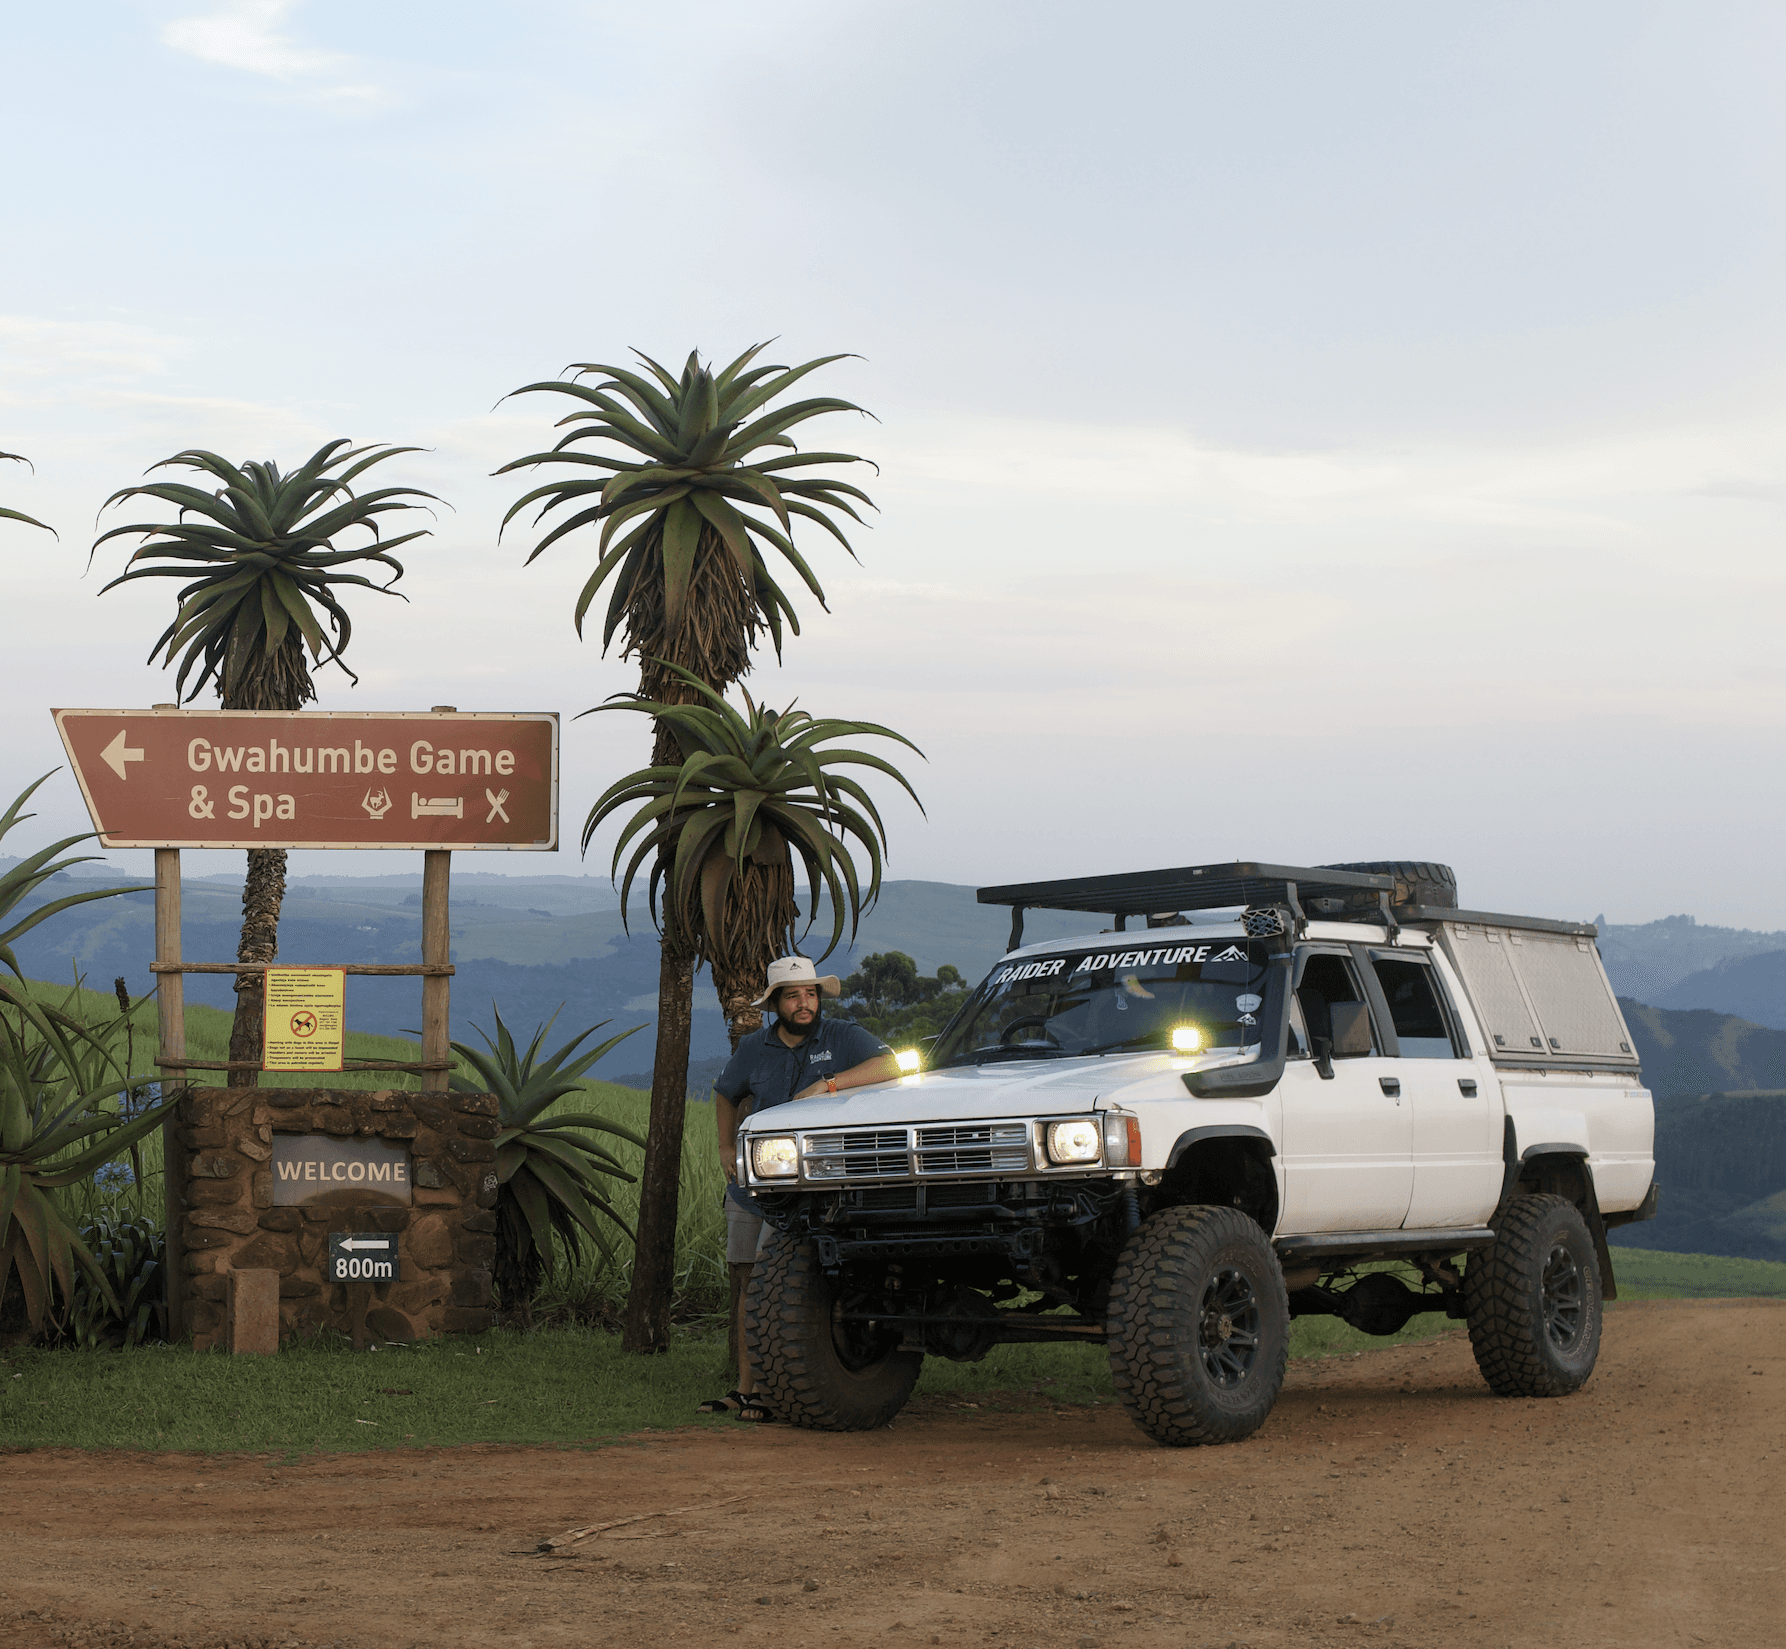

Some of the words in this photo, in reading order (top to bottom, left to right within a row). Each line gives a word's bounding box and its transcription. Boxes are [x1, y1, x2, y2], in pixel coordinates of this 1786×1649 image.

[187, 737, 398, 774] Gwahumbe
[410, 740, 516, 775] Game
[188, 784, 216, 819] &
[227, 784, 296, 828] Spa
[995, 959, 1066, 985] RAIDER
[1074, 945, 1212, 973] ADVENTURE
[277, 1161, 406, 1182] WELCOME
[335, 1257, 393, 1279] 800m
